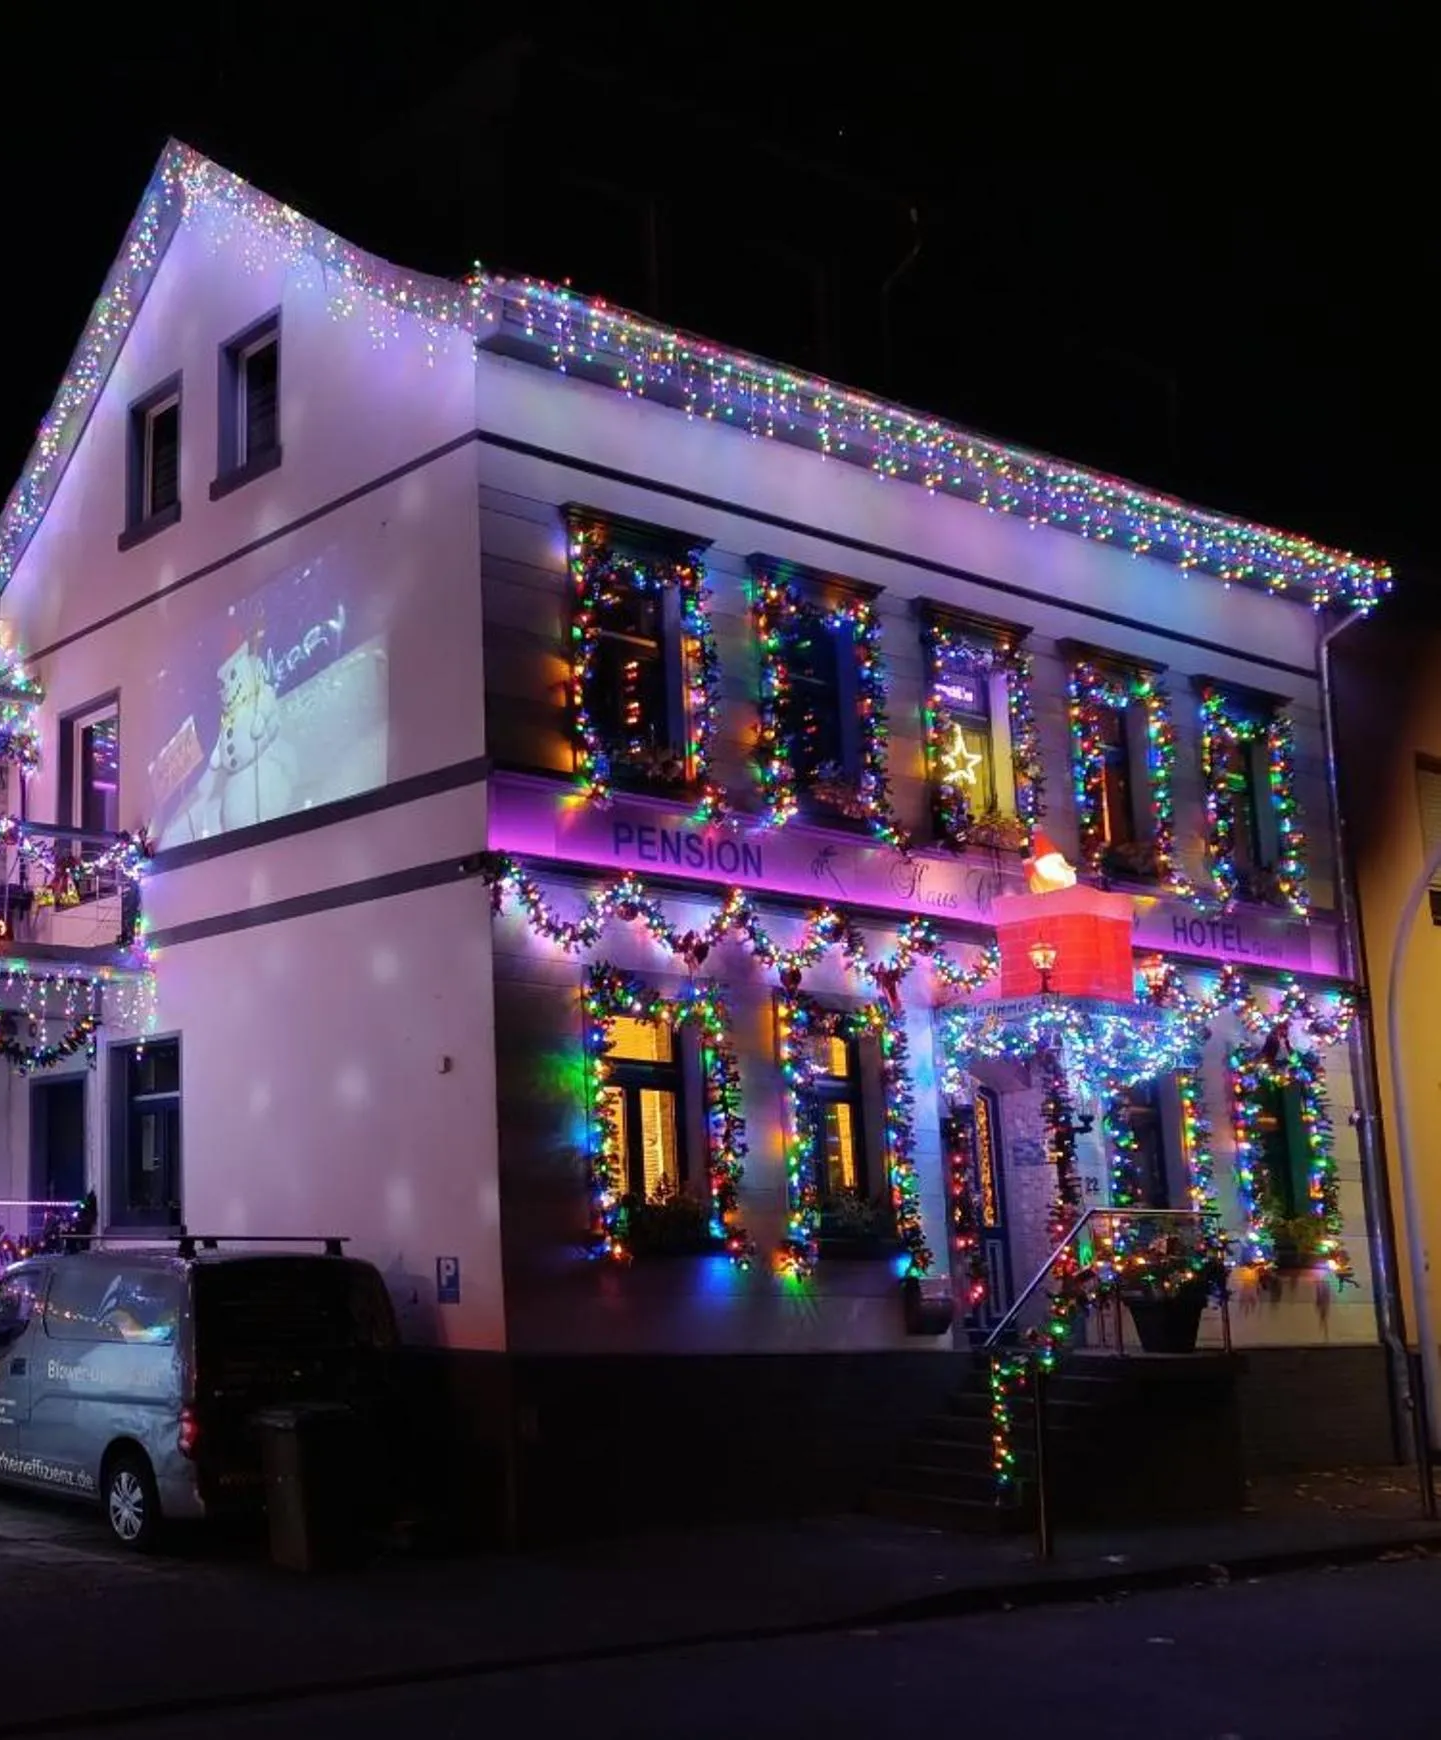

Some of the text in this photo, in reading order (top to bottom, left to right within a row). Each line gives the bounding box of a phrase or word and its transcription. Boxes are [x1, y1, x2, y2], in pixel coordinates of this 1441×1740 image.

[612, 822, 763, 878] PENSION
[888, 858, 959, 909] Haus
[1171, 914, 1250, 954] HOTEL
[440, 1259, 456, 1287] P
